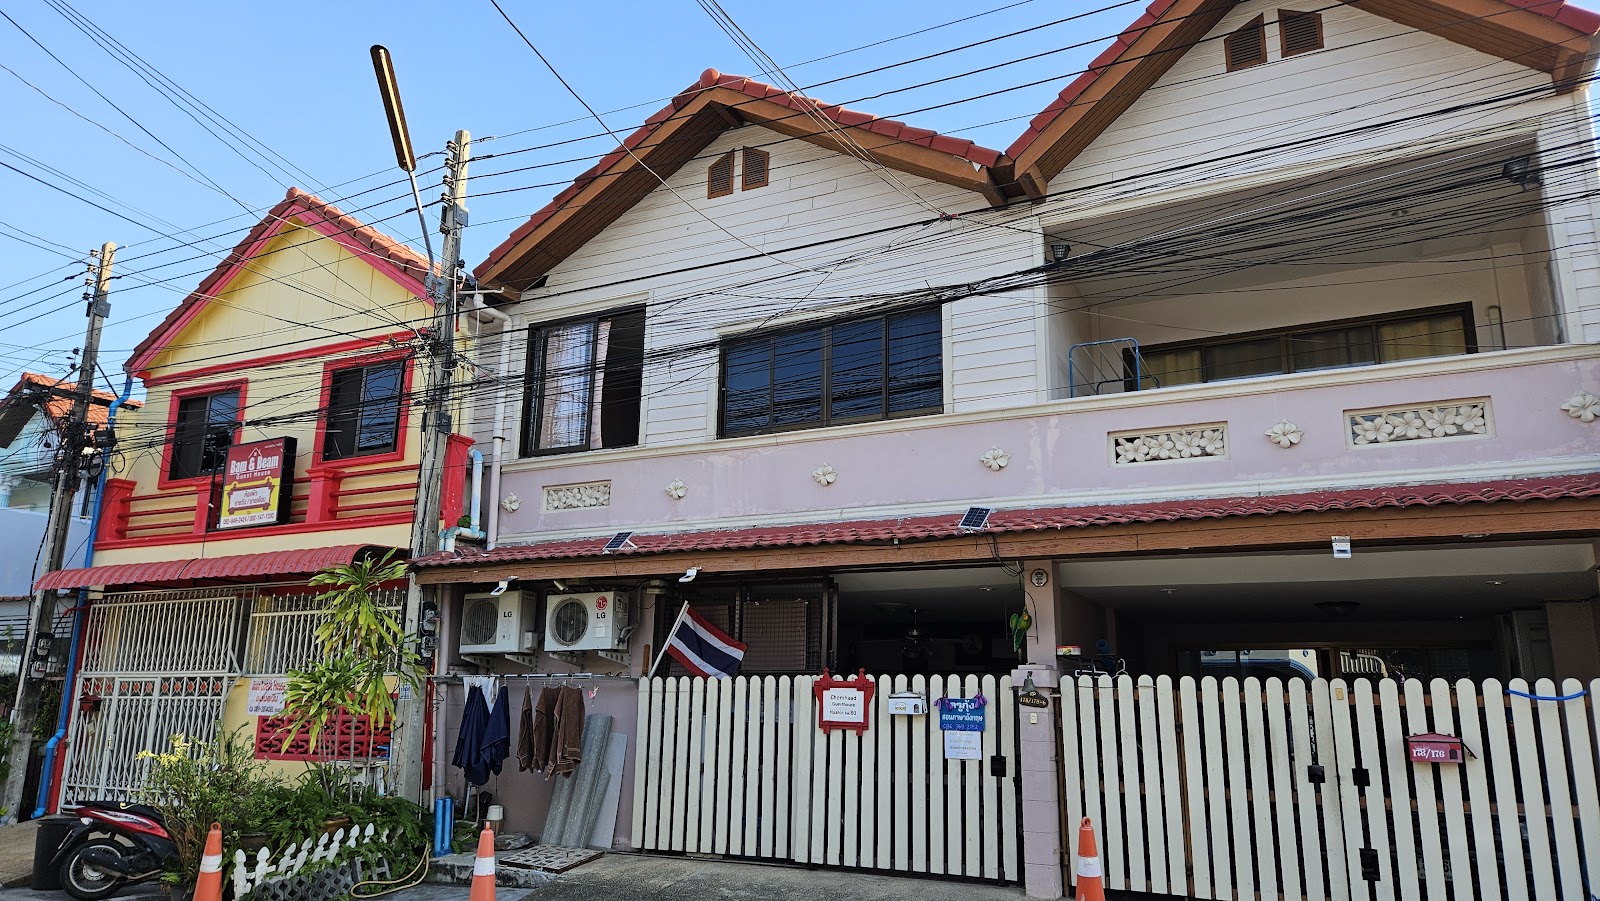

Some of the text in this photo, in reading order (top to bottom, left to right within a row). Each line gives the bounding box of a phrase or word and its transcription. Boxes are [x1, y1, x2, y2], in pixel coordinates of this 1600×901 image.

[230, 456, 279, 473] Bam & Beam
[596, 611, 606, 619] LG
[941, 712, 984, 723] สอนภาษาอังกฤษ
[1412, 748, 1445, 759] 178/176
